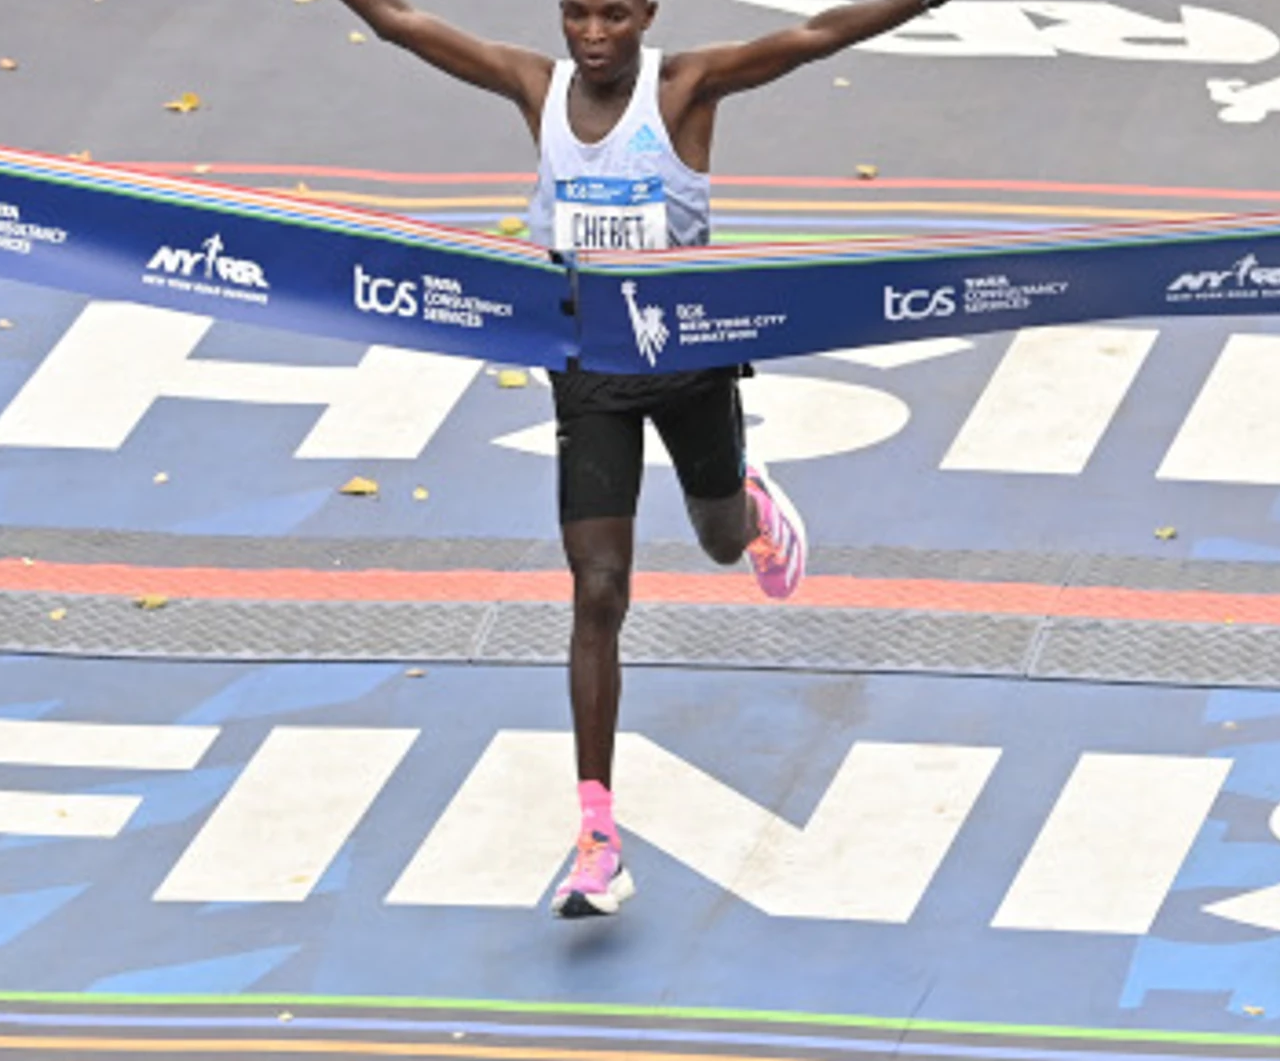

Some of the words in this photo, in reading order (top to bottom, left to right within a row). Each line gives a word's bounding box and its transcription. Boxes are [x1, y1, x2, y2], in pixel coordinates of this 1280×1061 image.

[573, 213, 645, 248] CHEBET
[354, 264, 418, 317] tcs
[884, 285, 956, 321] tcs
